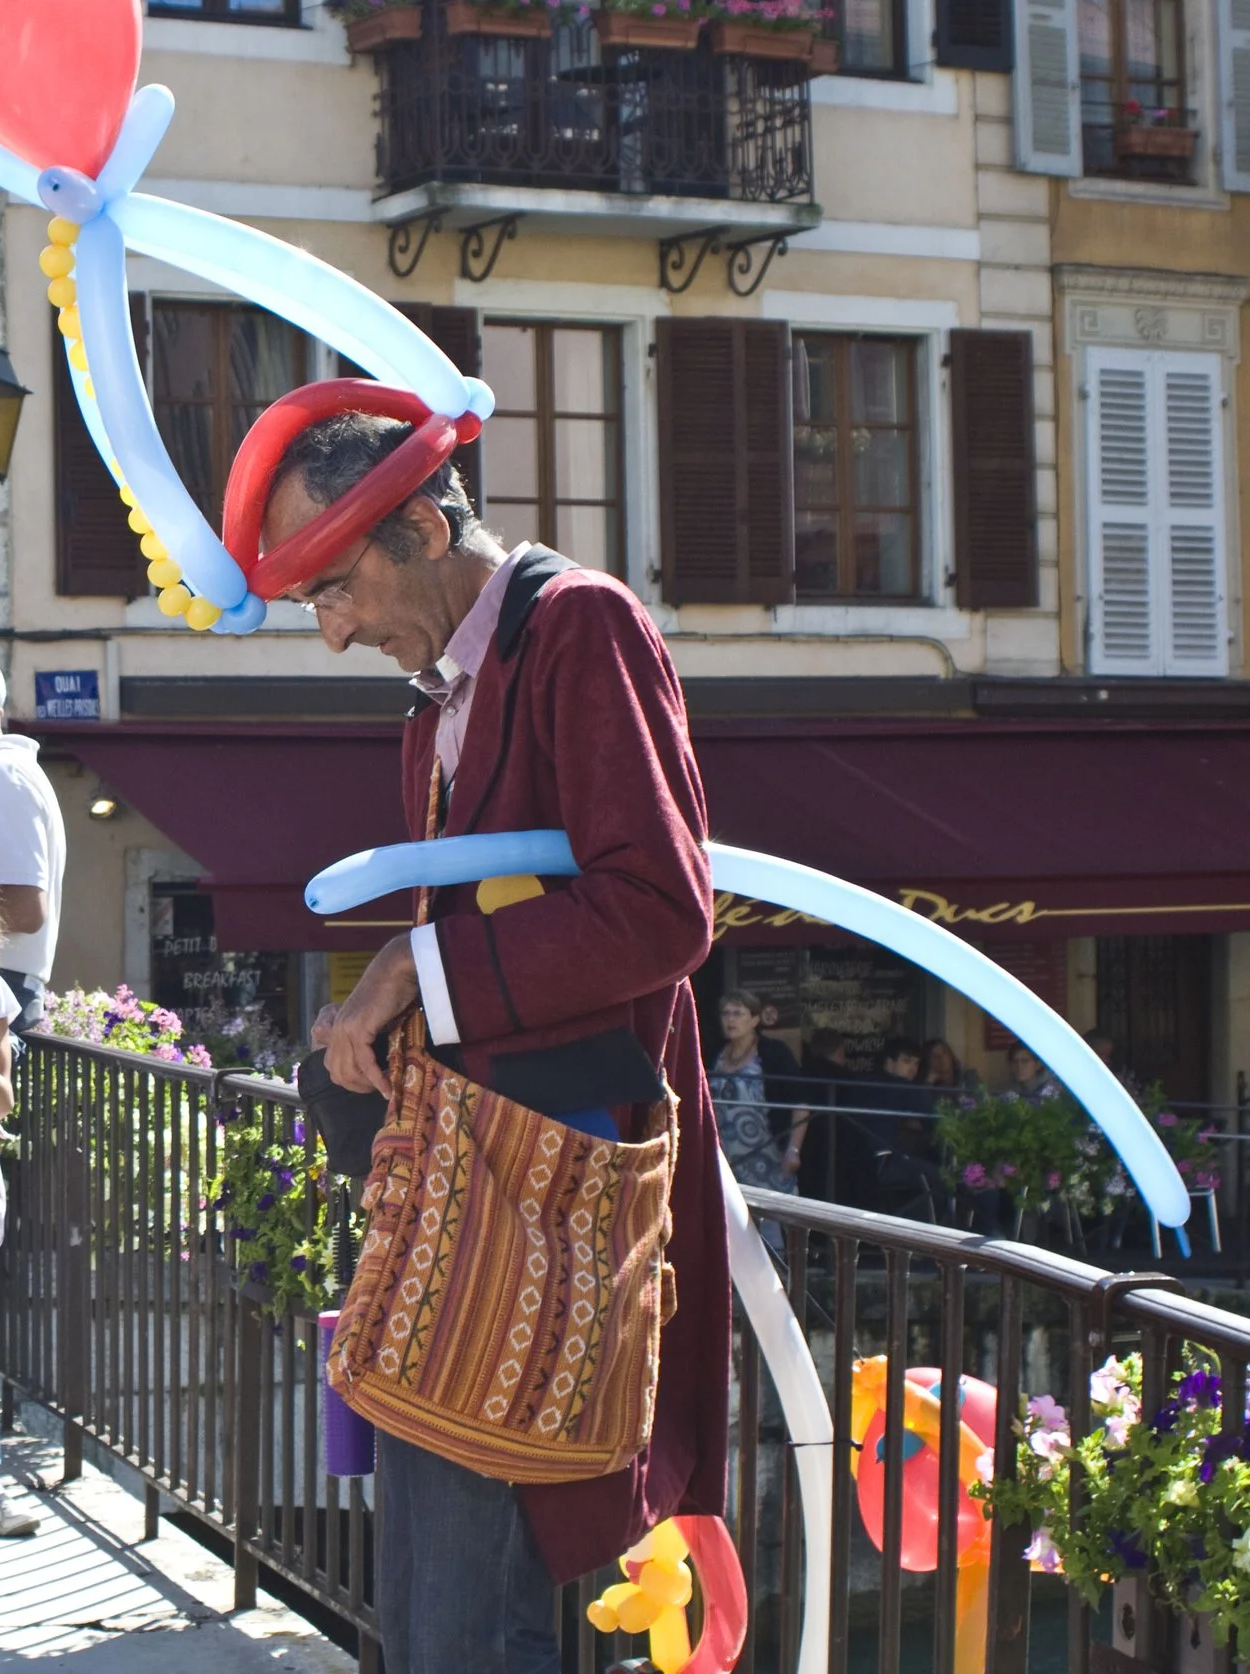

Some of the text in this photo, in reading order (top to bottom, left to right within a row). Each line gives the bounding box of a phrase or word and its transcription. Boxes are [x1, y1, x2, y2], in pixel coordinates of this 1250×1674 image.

[55, 675, 81, 693] QUAI
[900, 888, 1040, 925] Ducs
[164, 936, 201, 958] PETIT
[183, 970, 262, 990] BREAKFAST
